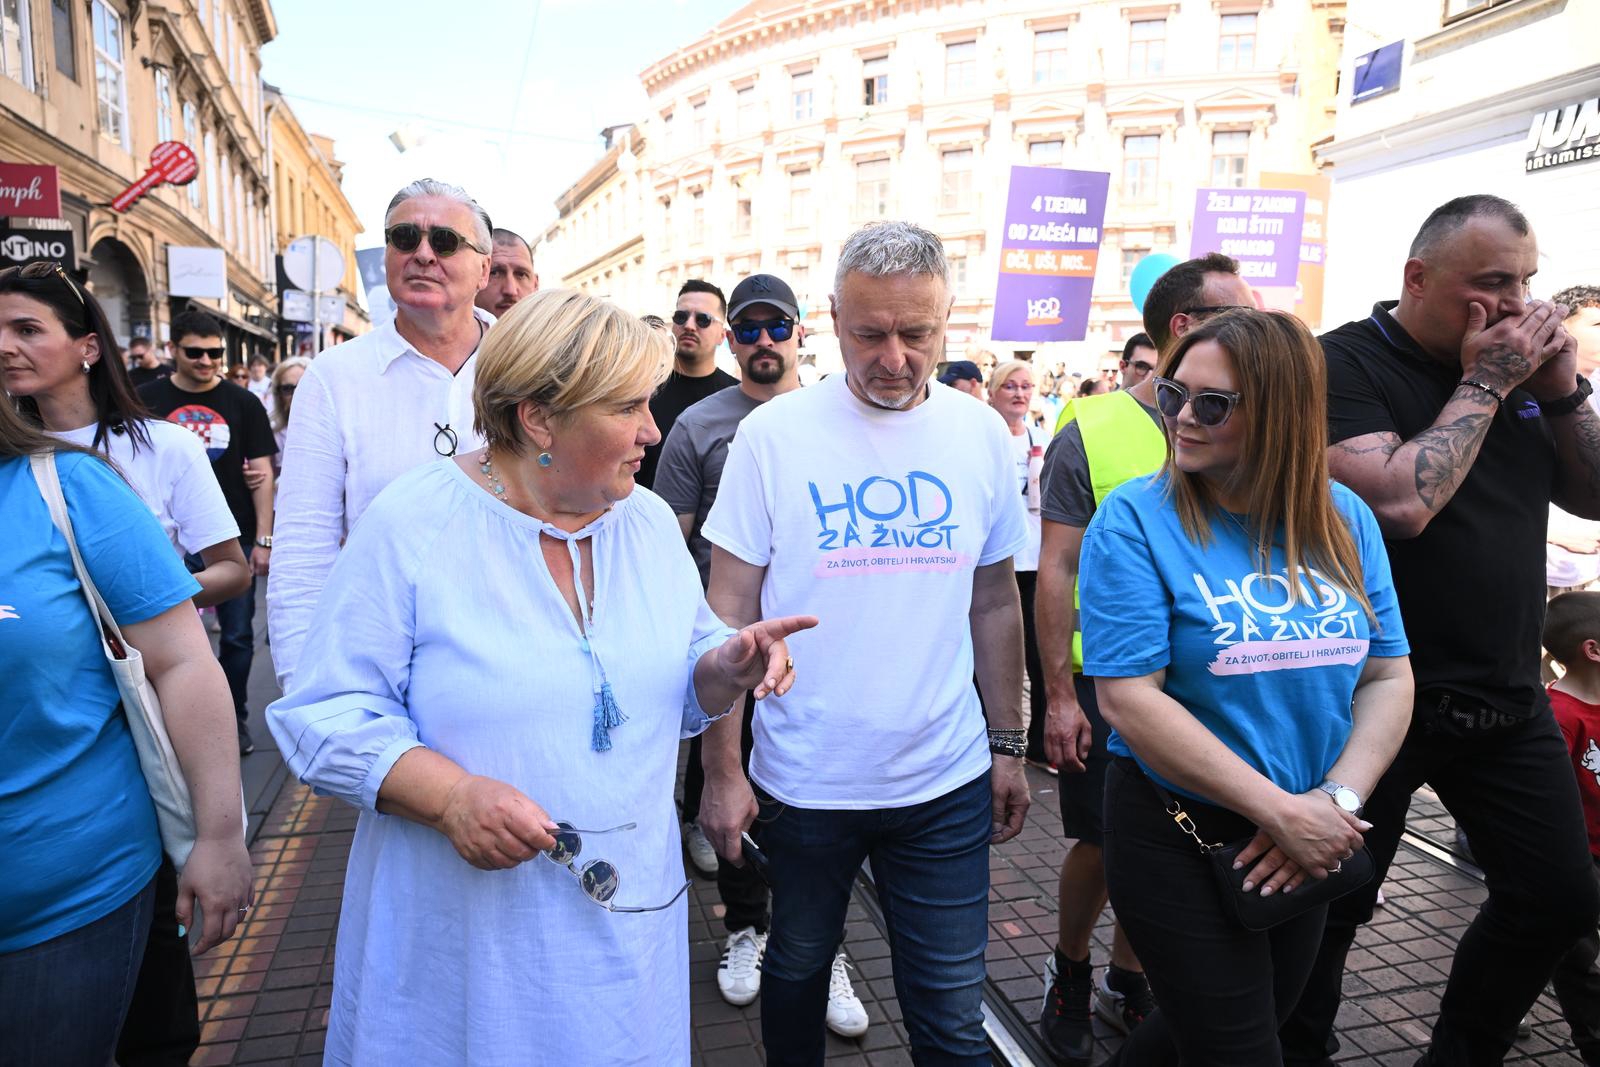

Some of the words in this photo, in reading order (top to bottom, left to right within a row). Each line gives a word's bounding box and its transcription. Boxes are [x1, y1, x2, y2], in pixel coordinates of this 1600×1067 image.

[1031, 195, 1042, 212] 4
[1044, 196, 1087, 214] TJEDNA
[1207, 191, 1251, 212] ŽELIM
[1252, 196, 1297, 213] ZAKON
[1008, 223, 1028, 240] OD
[1029, 222, 1076, 242] ZAČEĆA
[1077, 226, 1098, 243] IMA
[1217, 217, 1248, 234] KOJI
[1249, 214, 1284, 235] ŠTITI
[1006, 249, 1031, 271] OČI,
[1034, 250, 1057, 271] UŠI,
[1060, 254, 1092, 271] NOS...
[808, 470, 953, 531] HOD
[817, 521, 862, 550] ZA
[870, 522, 960, 550] ŽIVOT
[827, 560, 840, 569] ZA
[841, 558, 870, 568] ŽIVOT,
[870, 557, 904, 566] OBITELJ
[910, 556, 957, 565] HRVATSKU
[1192, 565, 1347, 624] HOD
[1211, 612, 1265, 645] ZA
[1269, 610, 1359, 641] ŽIVOT
[1225, 656, 1239, 665] ZA
[1241, 653, 1270, 664] ŽIVOT,
[1271, 650, 1310, 661] OBITELJ
[1316, 645, 1362, 657] HRVATSKU
